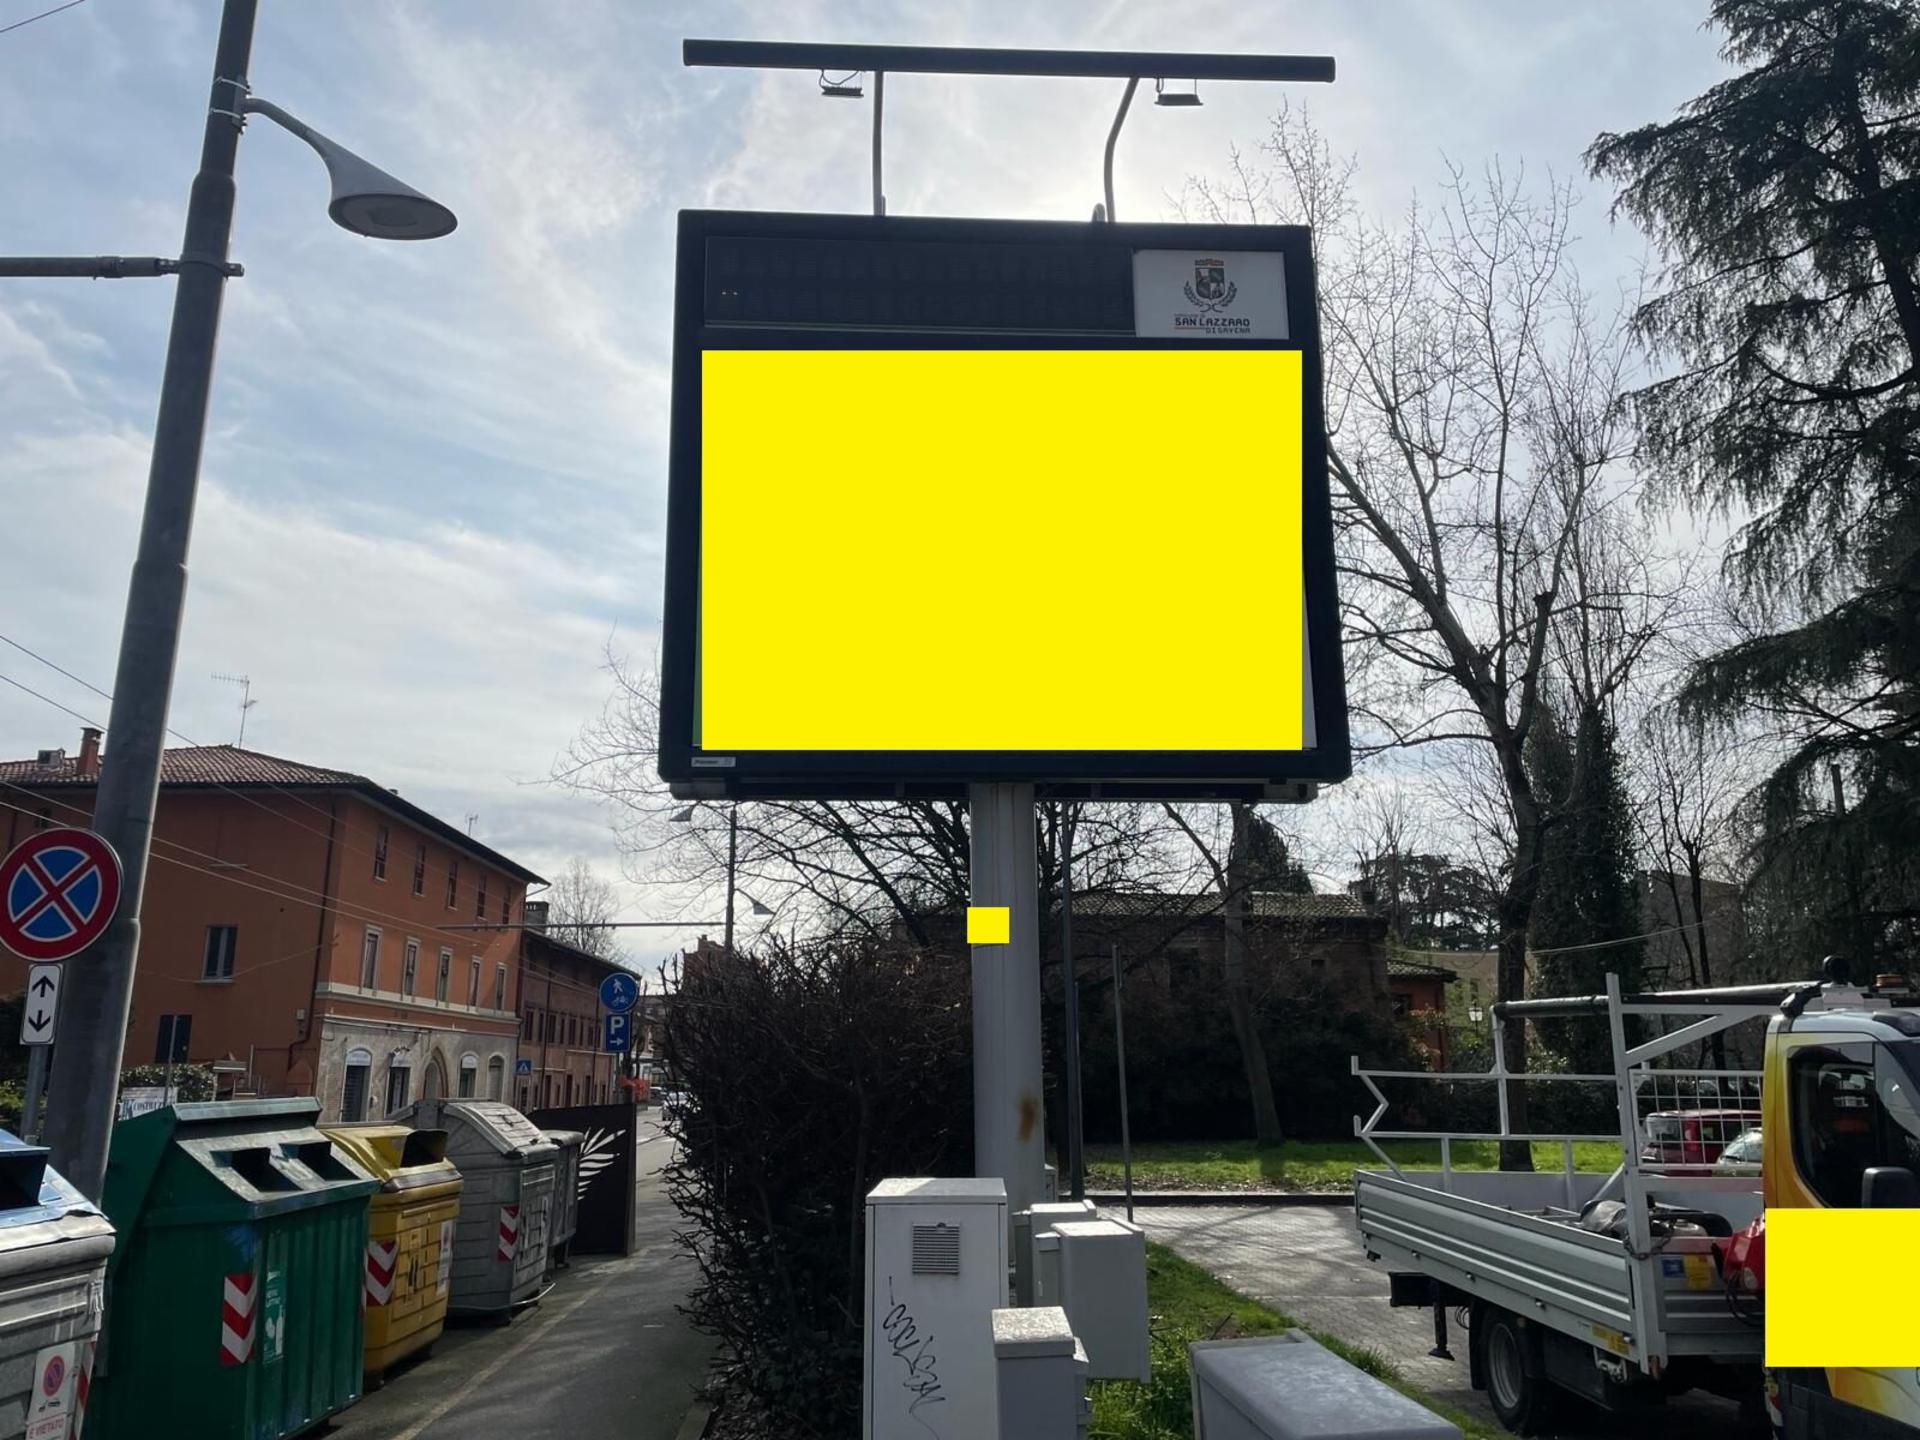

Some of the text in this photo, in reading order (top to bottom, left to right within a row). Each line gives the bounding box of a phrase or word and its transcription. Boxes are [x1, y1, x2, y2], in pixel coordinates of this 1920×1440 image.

[1175, 317, 1250, 327] SAN LAZZARO
[610, 1015, 625, 1035] P
